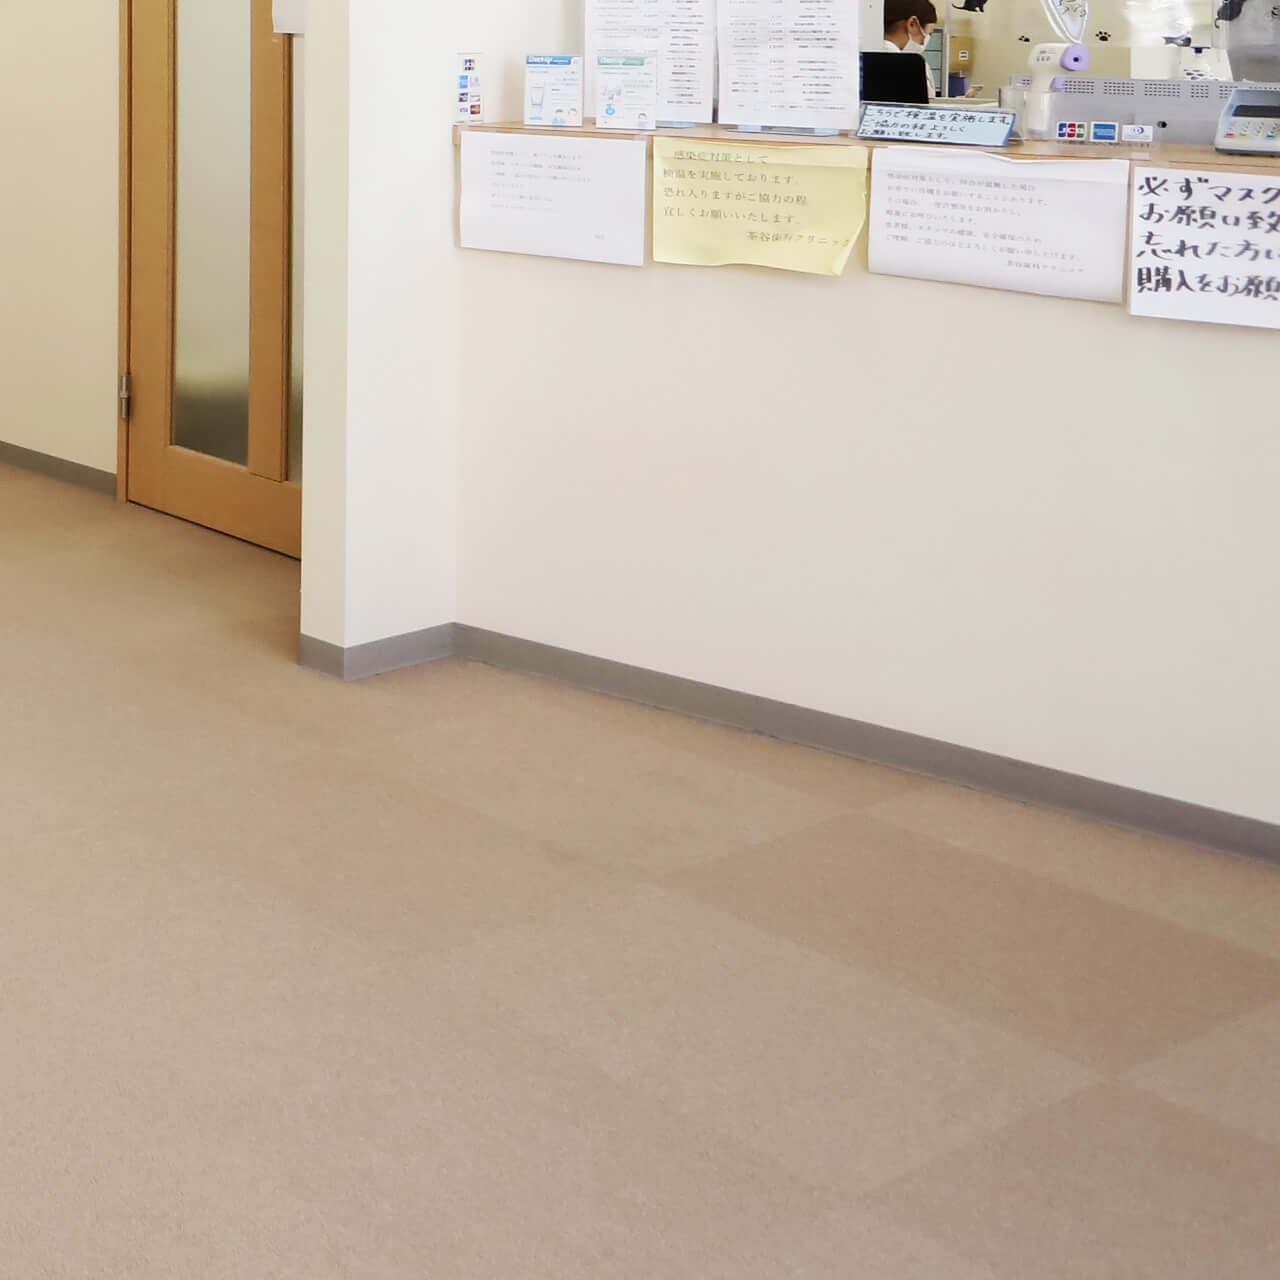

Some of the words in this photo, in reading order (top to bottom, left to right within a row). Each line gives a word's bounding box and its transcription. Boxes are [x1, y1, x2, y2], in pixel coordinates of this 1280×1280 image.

[1138, 176, 1280, 204] 必ずマスク
